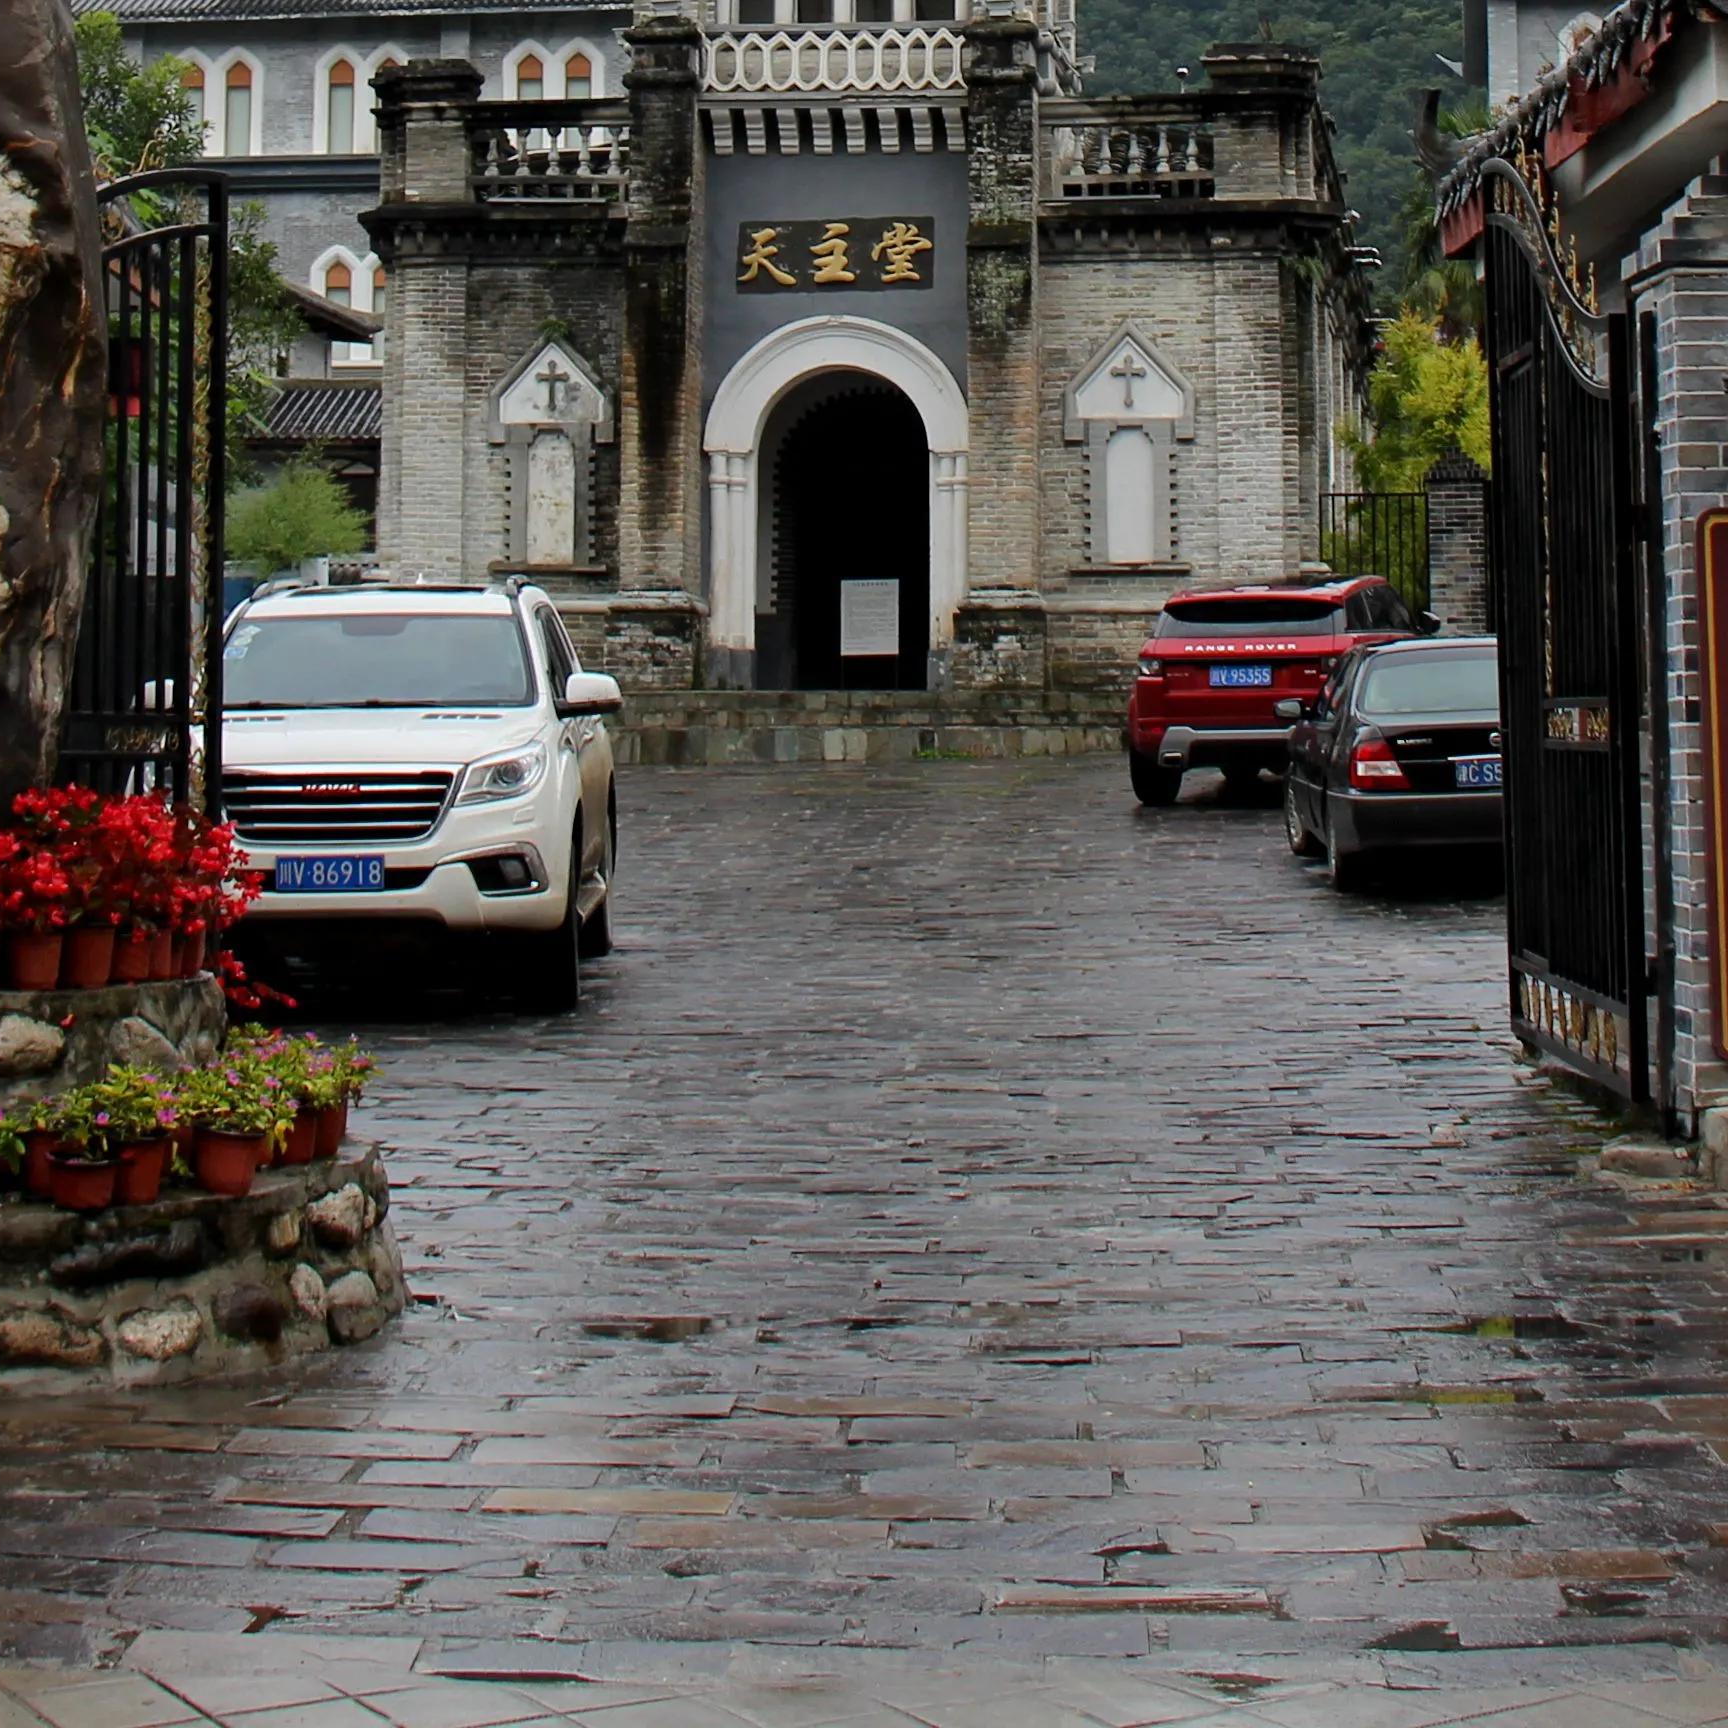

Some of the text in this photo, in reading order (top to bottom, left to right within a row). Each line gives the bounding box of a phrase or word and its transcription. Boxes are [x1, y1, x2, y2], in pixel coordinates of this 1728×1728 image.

[737, 222, 933, 285] 天主堂
[1245, 643, 1297, 651] ROVER
